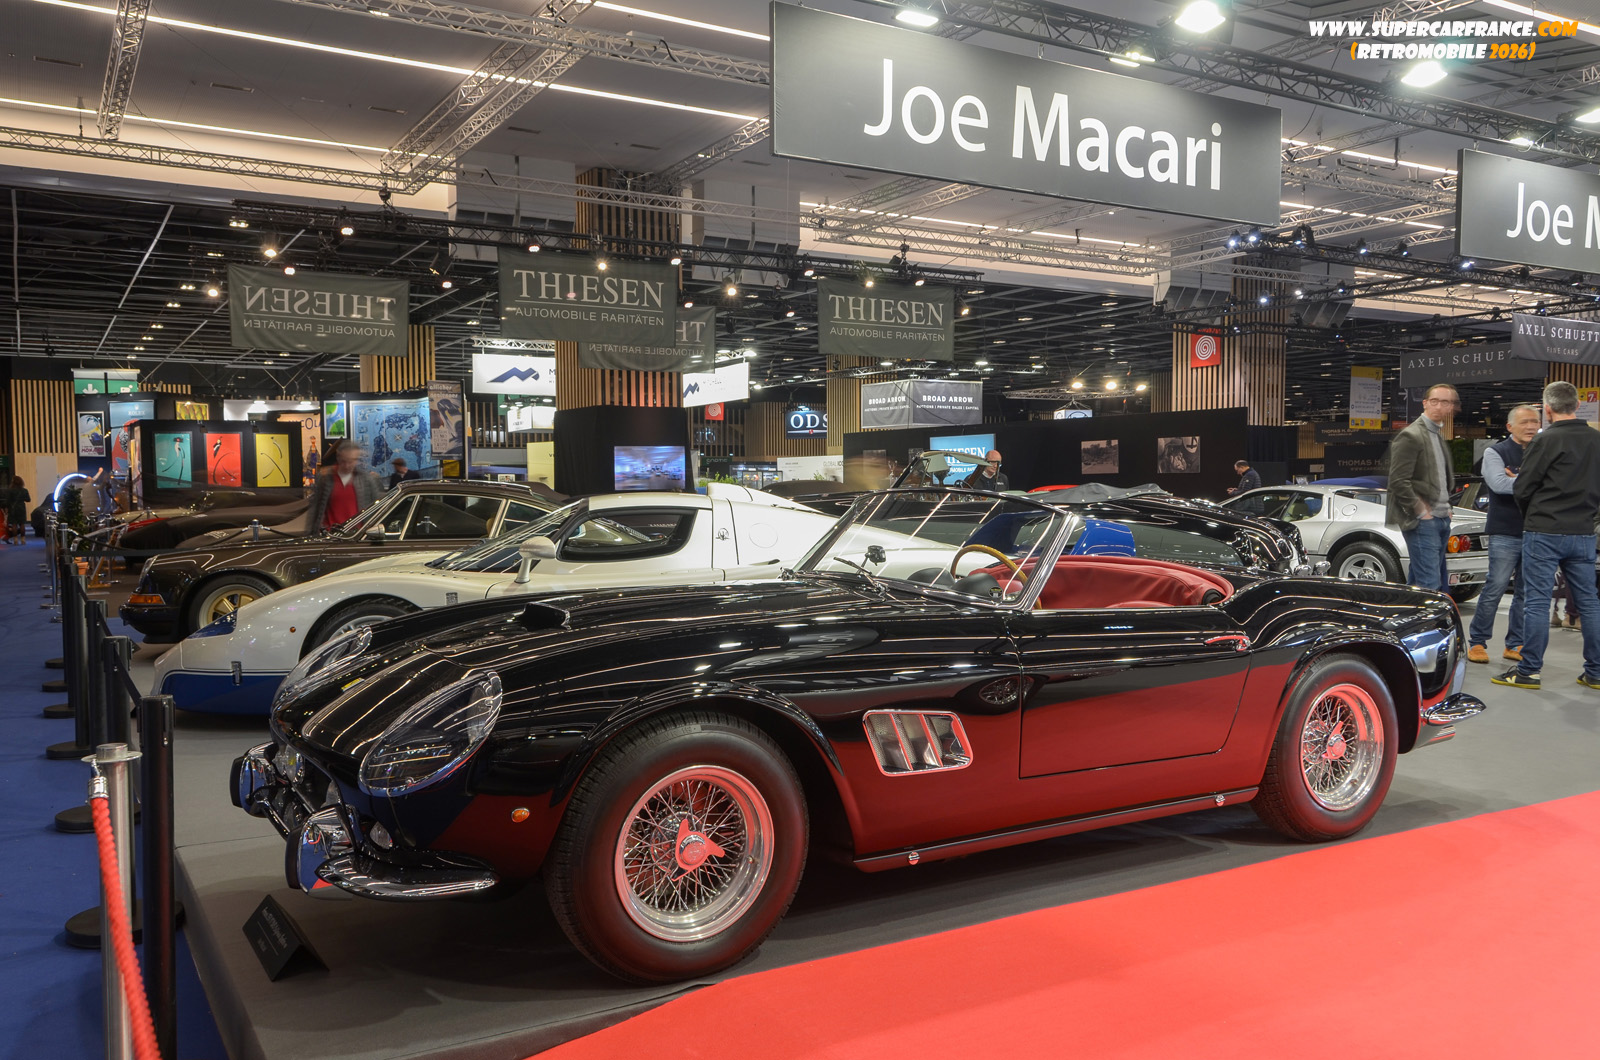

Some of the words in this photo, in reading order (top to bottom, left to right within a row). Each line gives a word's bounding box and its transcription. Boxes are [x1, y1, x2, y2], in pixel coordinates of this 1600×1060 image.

[863, 57, 989, 152] Joe
[1012, 84, 1222, 191] Macari
[1506, 182, 1574, 246] Joe
[513, 269, 664, 308] THIESEN
[515, 307, 597, 321] AUTOMOBILE
[601, 312, 665, 326] RARITÄTEN
[828, 294, 944, 326] THIESEN
[830, 326, 893, 339] AUTOMOBILE
[895, 331, 945, 342] RARITÄTEN
[1518, 323, 1546, 337] AXEL
[1546, 346, 1562, 355] FINE
[1563, 347, 1579, 356] CARS
[1408, 356, 1444, 369] AXEL
[1446, 370, 1466, 378] FINE
[1471, 368, 1494, 376] CARS
[868, 397, 886, 405] BROAD
[887, 395, 906, 404] ARROW
[922, 395, 947, 403] BROAD
[948, 396, 974, 404] ARROW
